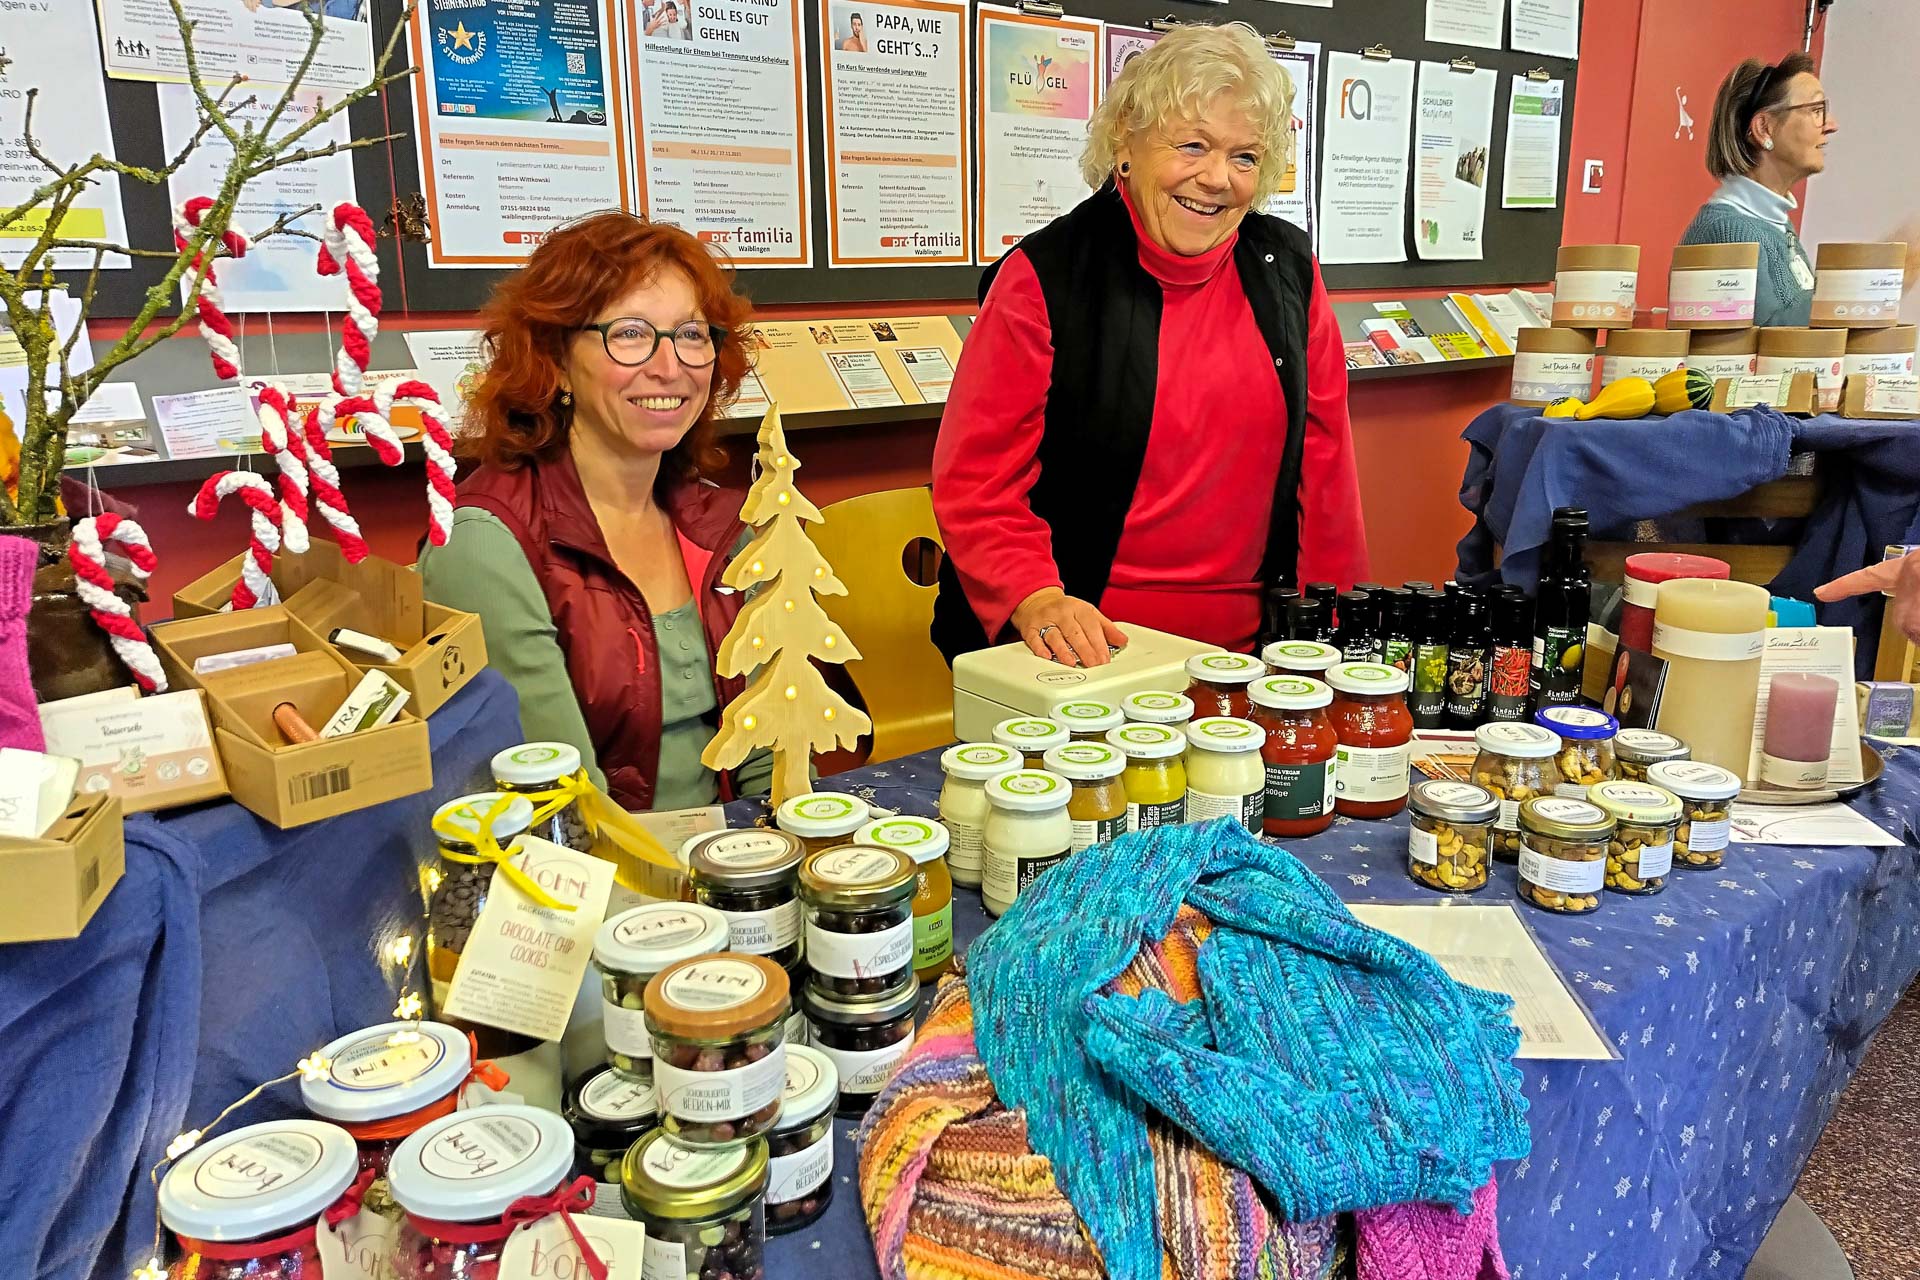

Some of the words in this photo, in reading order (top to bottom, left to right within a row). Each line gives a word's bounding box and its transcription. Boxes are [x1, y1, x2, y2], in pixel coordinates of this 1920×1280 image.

[699, 7, 726, 21] SOLL
[730, 11, 742, 22] ES
[746, 12, 768, 26] GUT
[876, 14, 914, 34] PAPA,
[917, 18, 941, 34] WIE
[700, 28, 740, 42] GEHEN
[645, 44, 682, 54] Hilfestellung
[722, 52, 748, 60] Trennung
[762, 55, 789, 65] Scheidung
[1113, 44, 1127, 72] Frauen
[866, 66, 890, 74] werdende
[901, 69, 914, 77] junge
[455, 139, 474, 147] fragen
[732, 227, 793, 243] familia
[910, 232, 961, 247] familia
[500, 920, 555, 950] CHOCOLATE
[555, 936, 575, 954] CHIP
[511, 944, 549, 968] COOKIES
[683, 1097, 731, 1112] BEEREN-MIX
